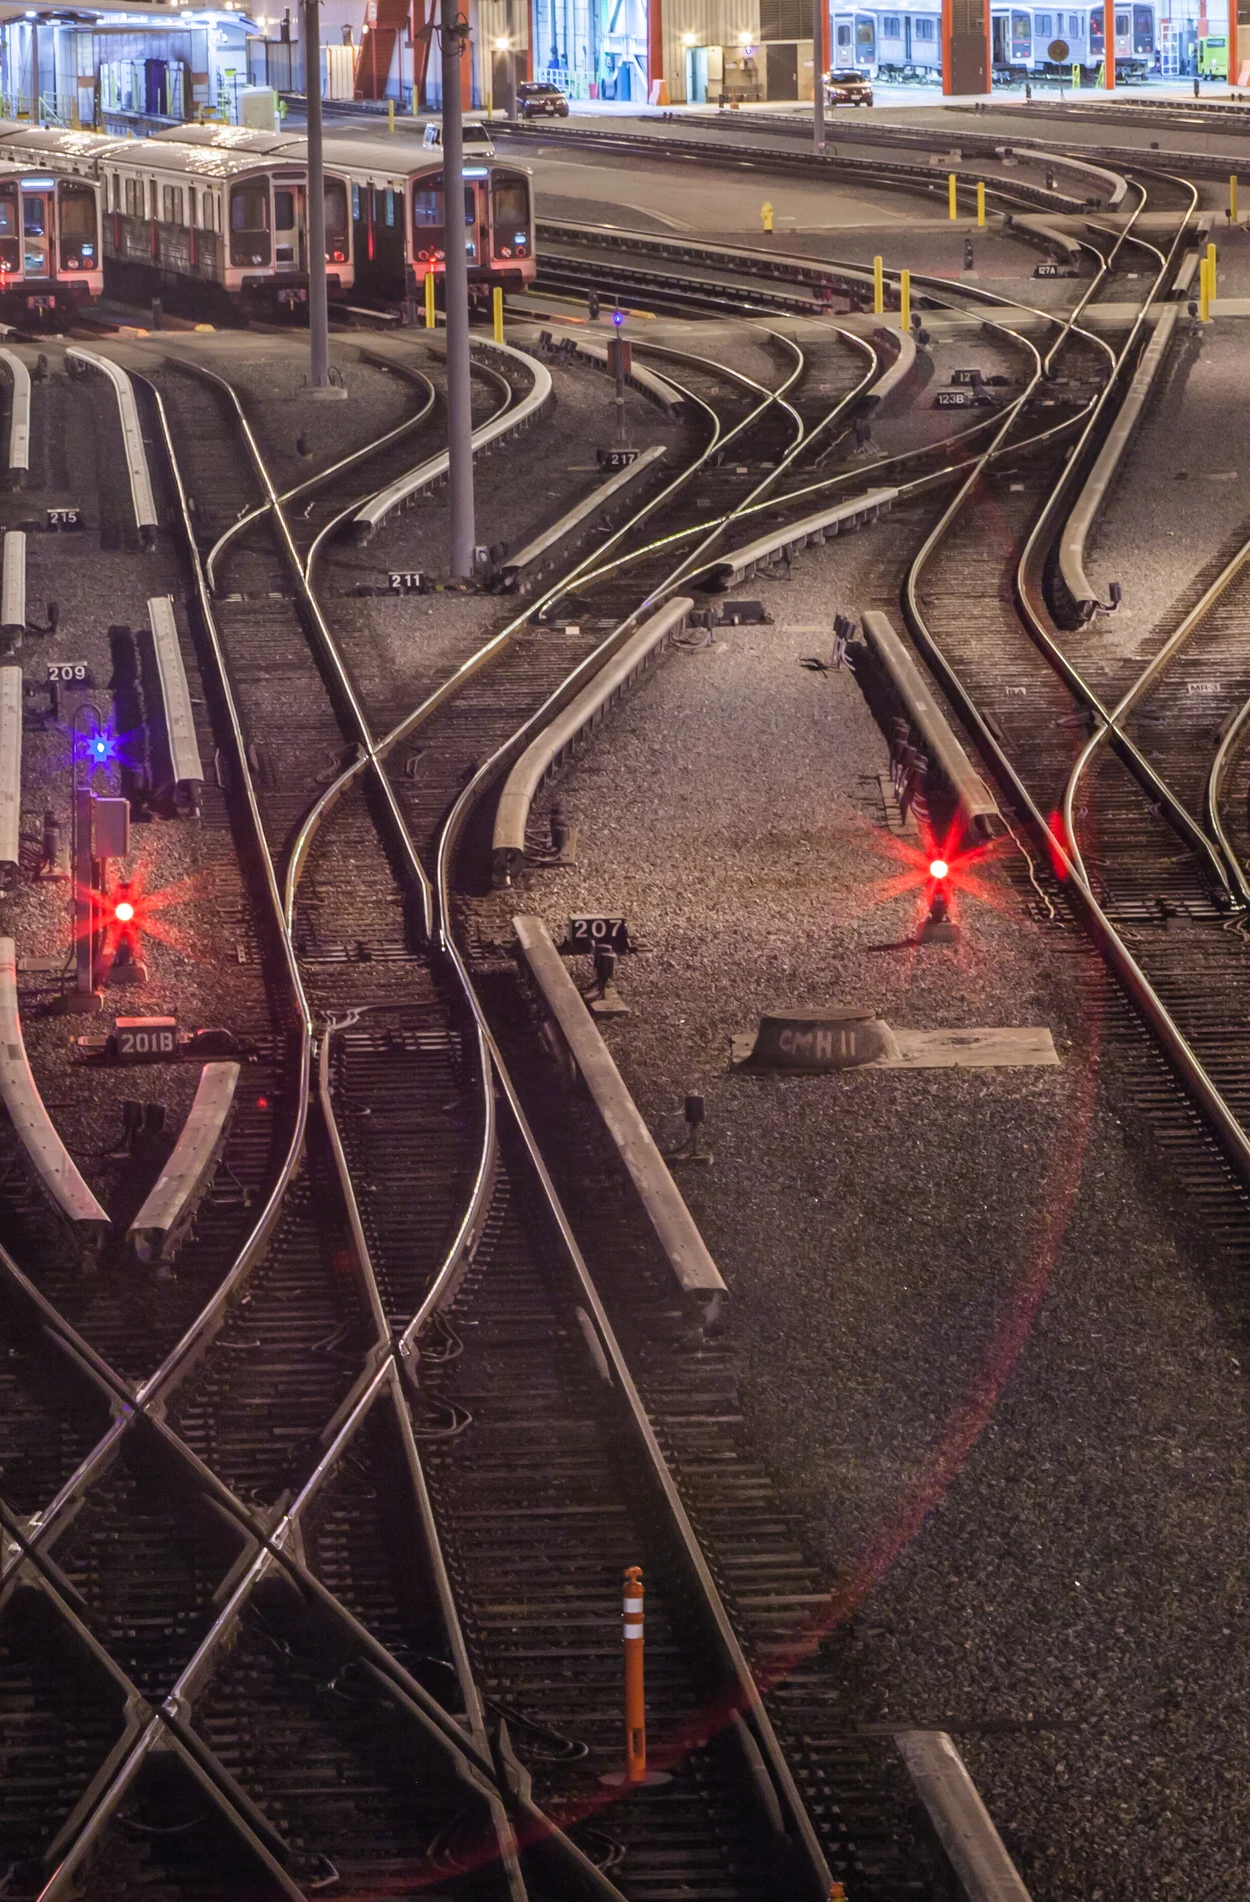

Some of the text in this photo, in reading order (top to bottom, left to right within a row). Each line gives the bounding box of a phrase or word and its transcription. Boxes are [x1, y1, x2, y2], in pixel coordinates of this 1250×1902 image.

[1038, 266, 1056, 274] 127A
[938, 394, 964, 404] 123B
[611, 454, 635, 465] 217
[50, 512, 77, 523] 215
[391, 574, 420, 588] 211
[48, 666, 86, 681] 209
[574, 920, 623, 938] 207
[121, 1032, 174, 1053] 201B
